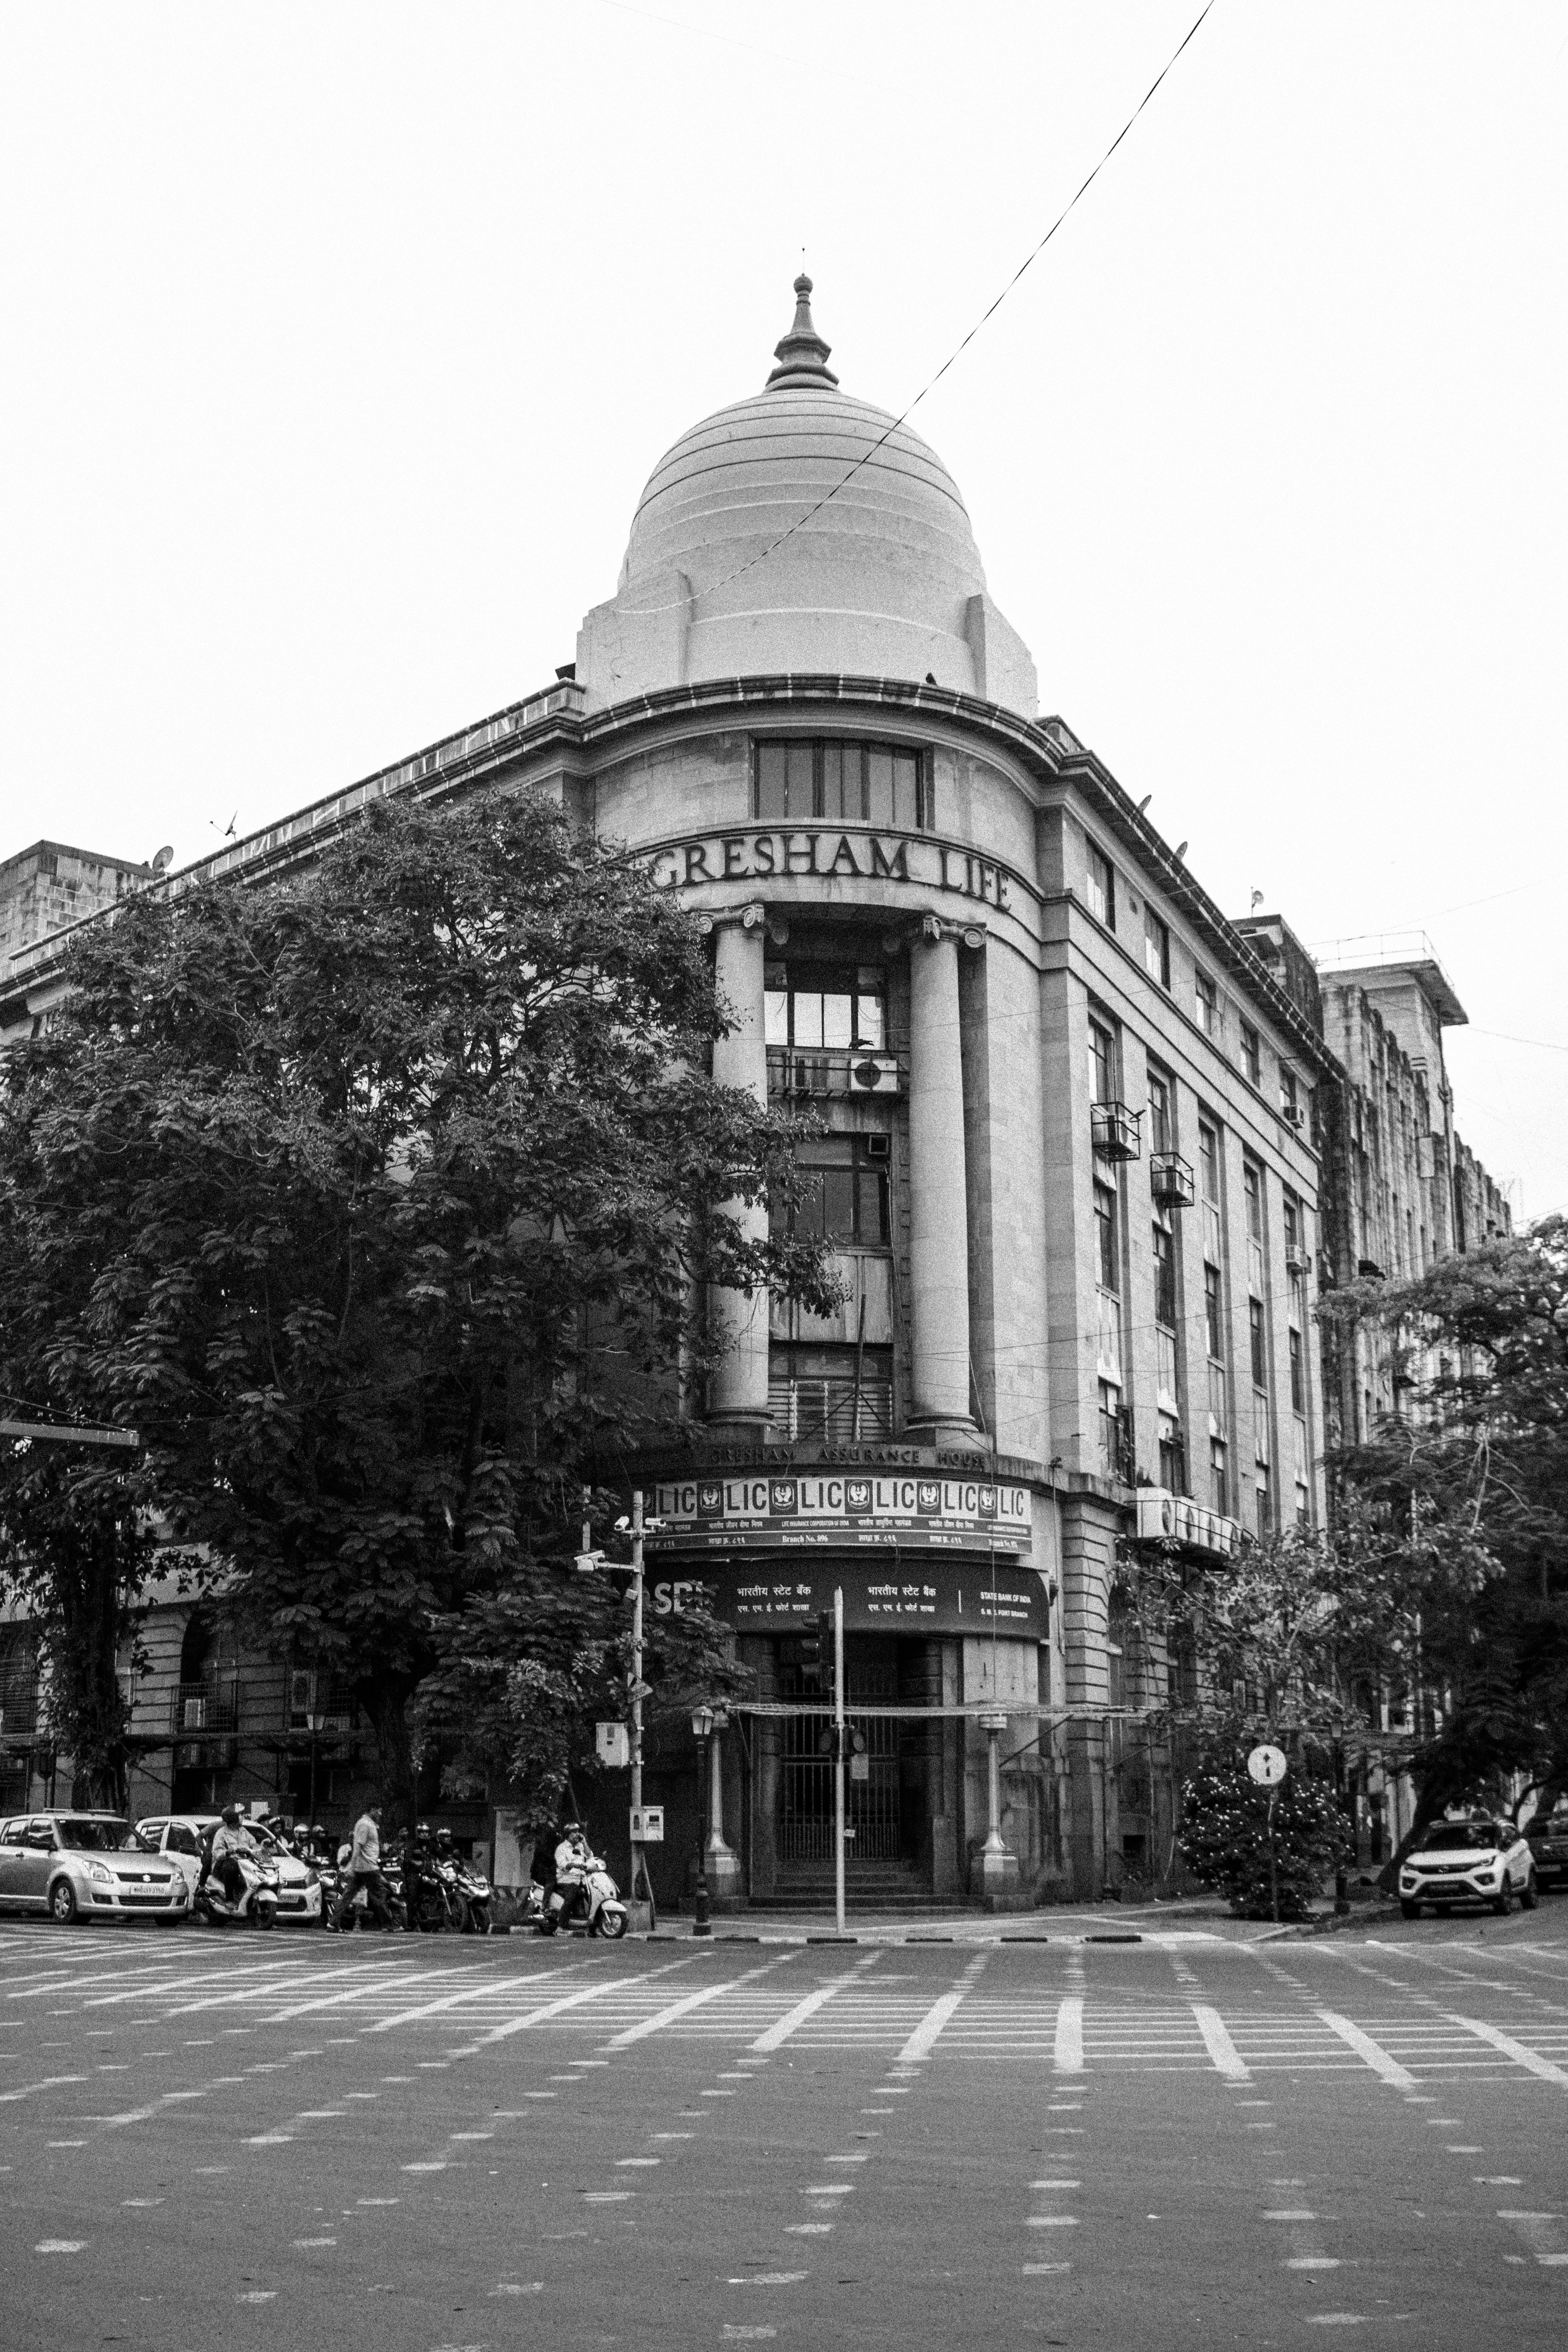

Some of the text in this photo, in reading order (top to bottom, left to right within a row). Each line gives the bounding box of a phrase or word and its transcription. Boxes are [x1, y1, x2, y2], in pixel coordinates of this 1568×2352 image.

[647, 834, 1011, 912] GRESHAM LIFE
[711, 1448, 986, 1468] GRESHAM ASSURANCE HOUSE
[659, 1486, 695, 1514] LIC
[727, 1483, 766, 1510] LIC
[802, 1482, 842, 1508] LIC
[877, 1482, 914, 1508] LIC
[945, 1484, 976, 1511] LIC
[1001, 1489, 1023, 1516] LIC
[737, 1585, 768, 1596] भारतीय
[773, 1584, 791, 1595] स्टेट
[868, 1584, 898, 1596] भारतीय
[902, 1584, 919, 1596] स्टेट
[980, 1592, 997, 1600] STATE
[998, 1593, 1012, 1601] BANK
[1019, 1595, 1031, 1604] INDIA
[1011, 1610, 1028, 1618] BRANCH
